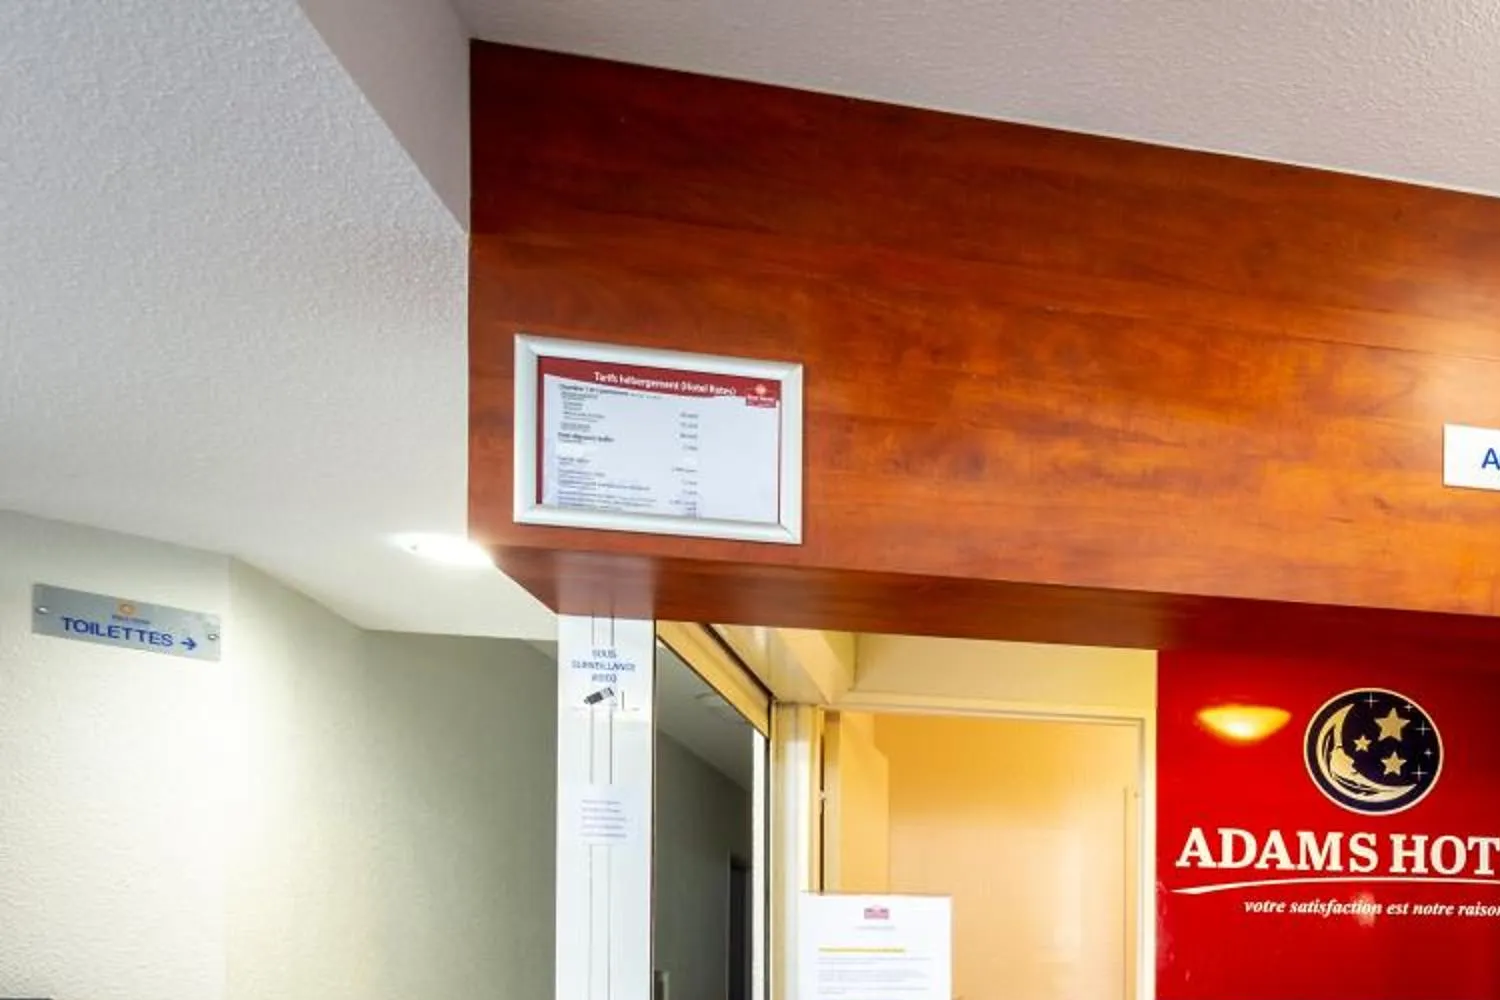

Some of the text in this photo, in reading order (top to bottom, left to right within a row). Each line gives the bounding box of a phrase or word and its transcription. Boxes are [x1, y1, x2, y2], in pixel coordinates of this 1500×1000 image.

[61, 616, 174, 647] TOILETTES
[1175, 827, 1379, 873] ADAMS
[1244, 900, 1286, 914] votre
[1289, 898, 1383, 918] satisfaction
[1386, 902, 1409, 916] est
[1412, 902, 1455, 917] notre
